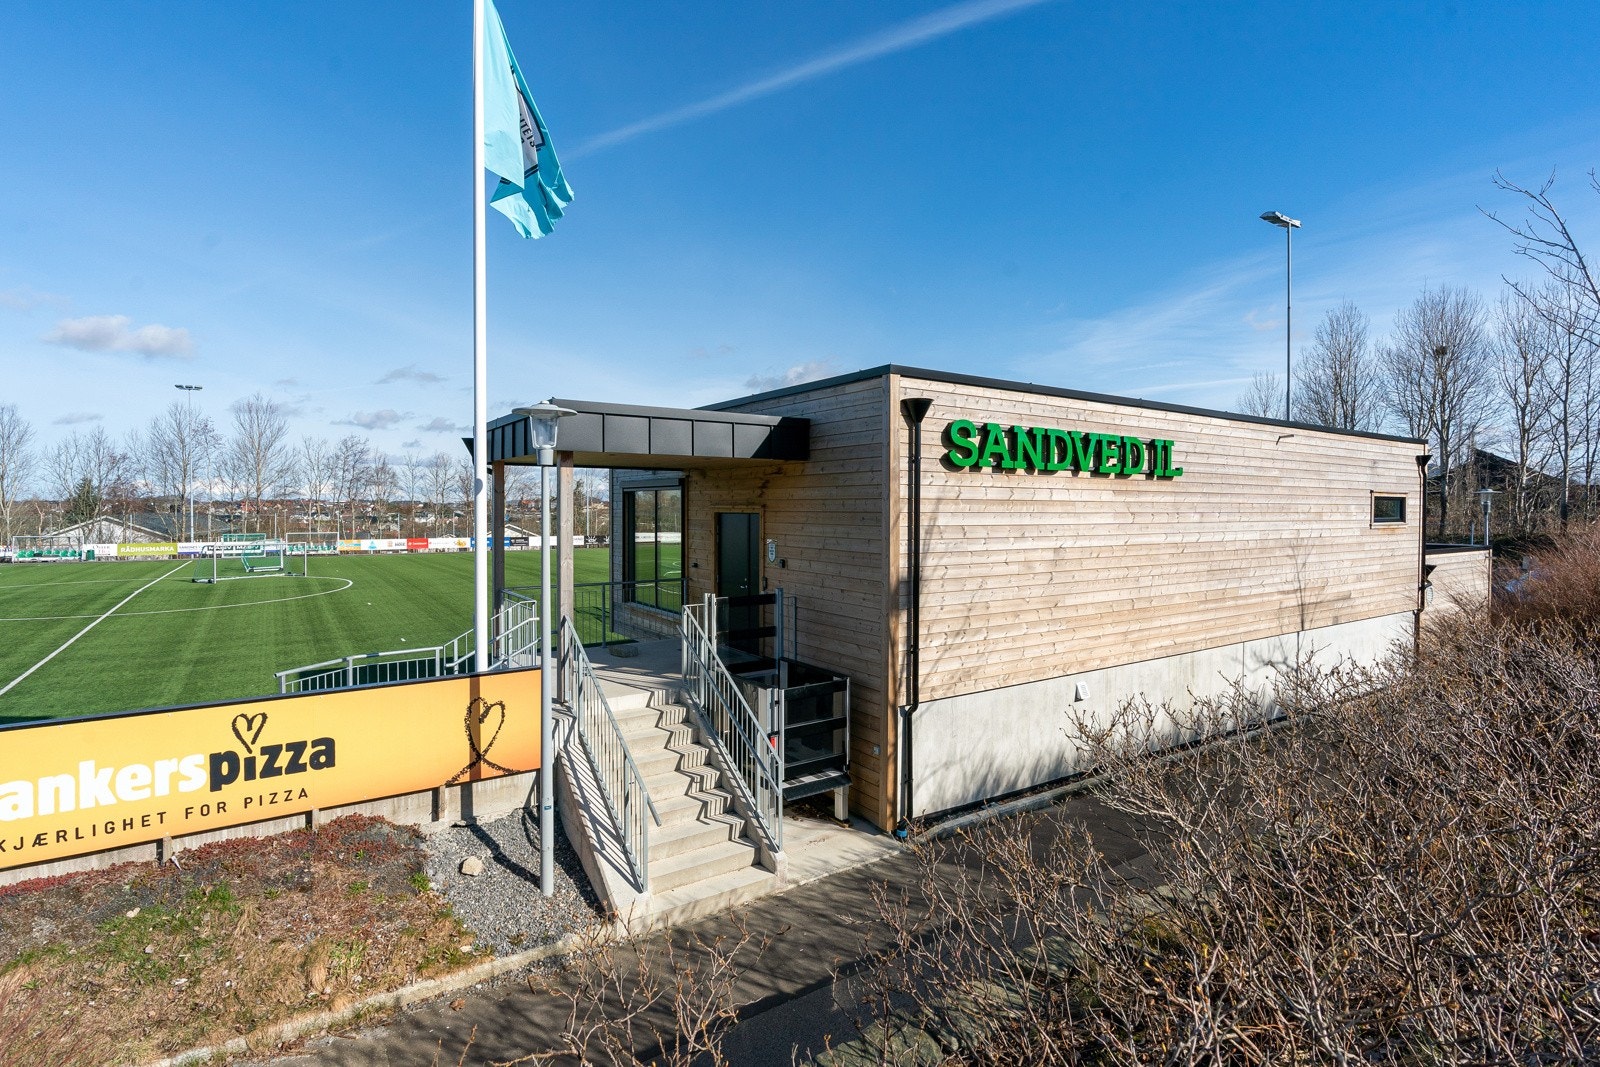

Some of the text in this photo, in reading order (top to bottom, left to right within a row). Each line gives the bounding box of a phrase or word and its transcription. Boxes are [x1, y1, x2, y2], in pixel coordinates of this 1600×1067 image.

[949, 419, 1184, 477] SANDVED IL
[121, 545, 174, 553] RÅDHUSMARKA
[185, 801, 228, 820] FOR
[244, 787, 309, 809] PIZZA
